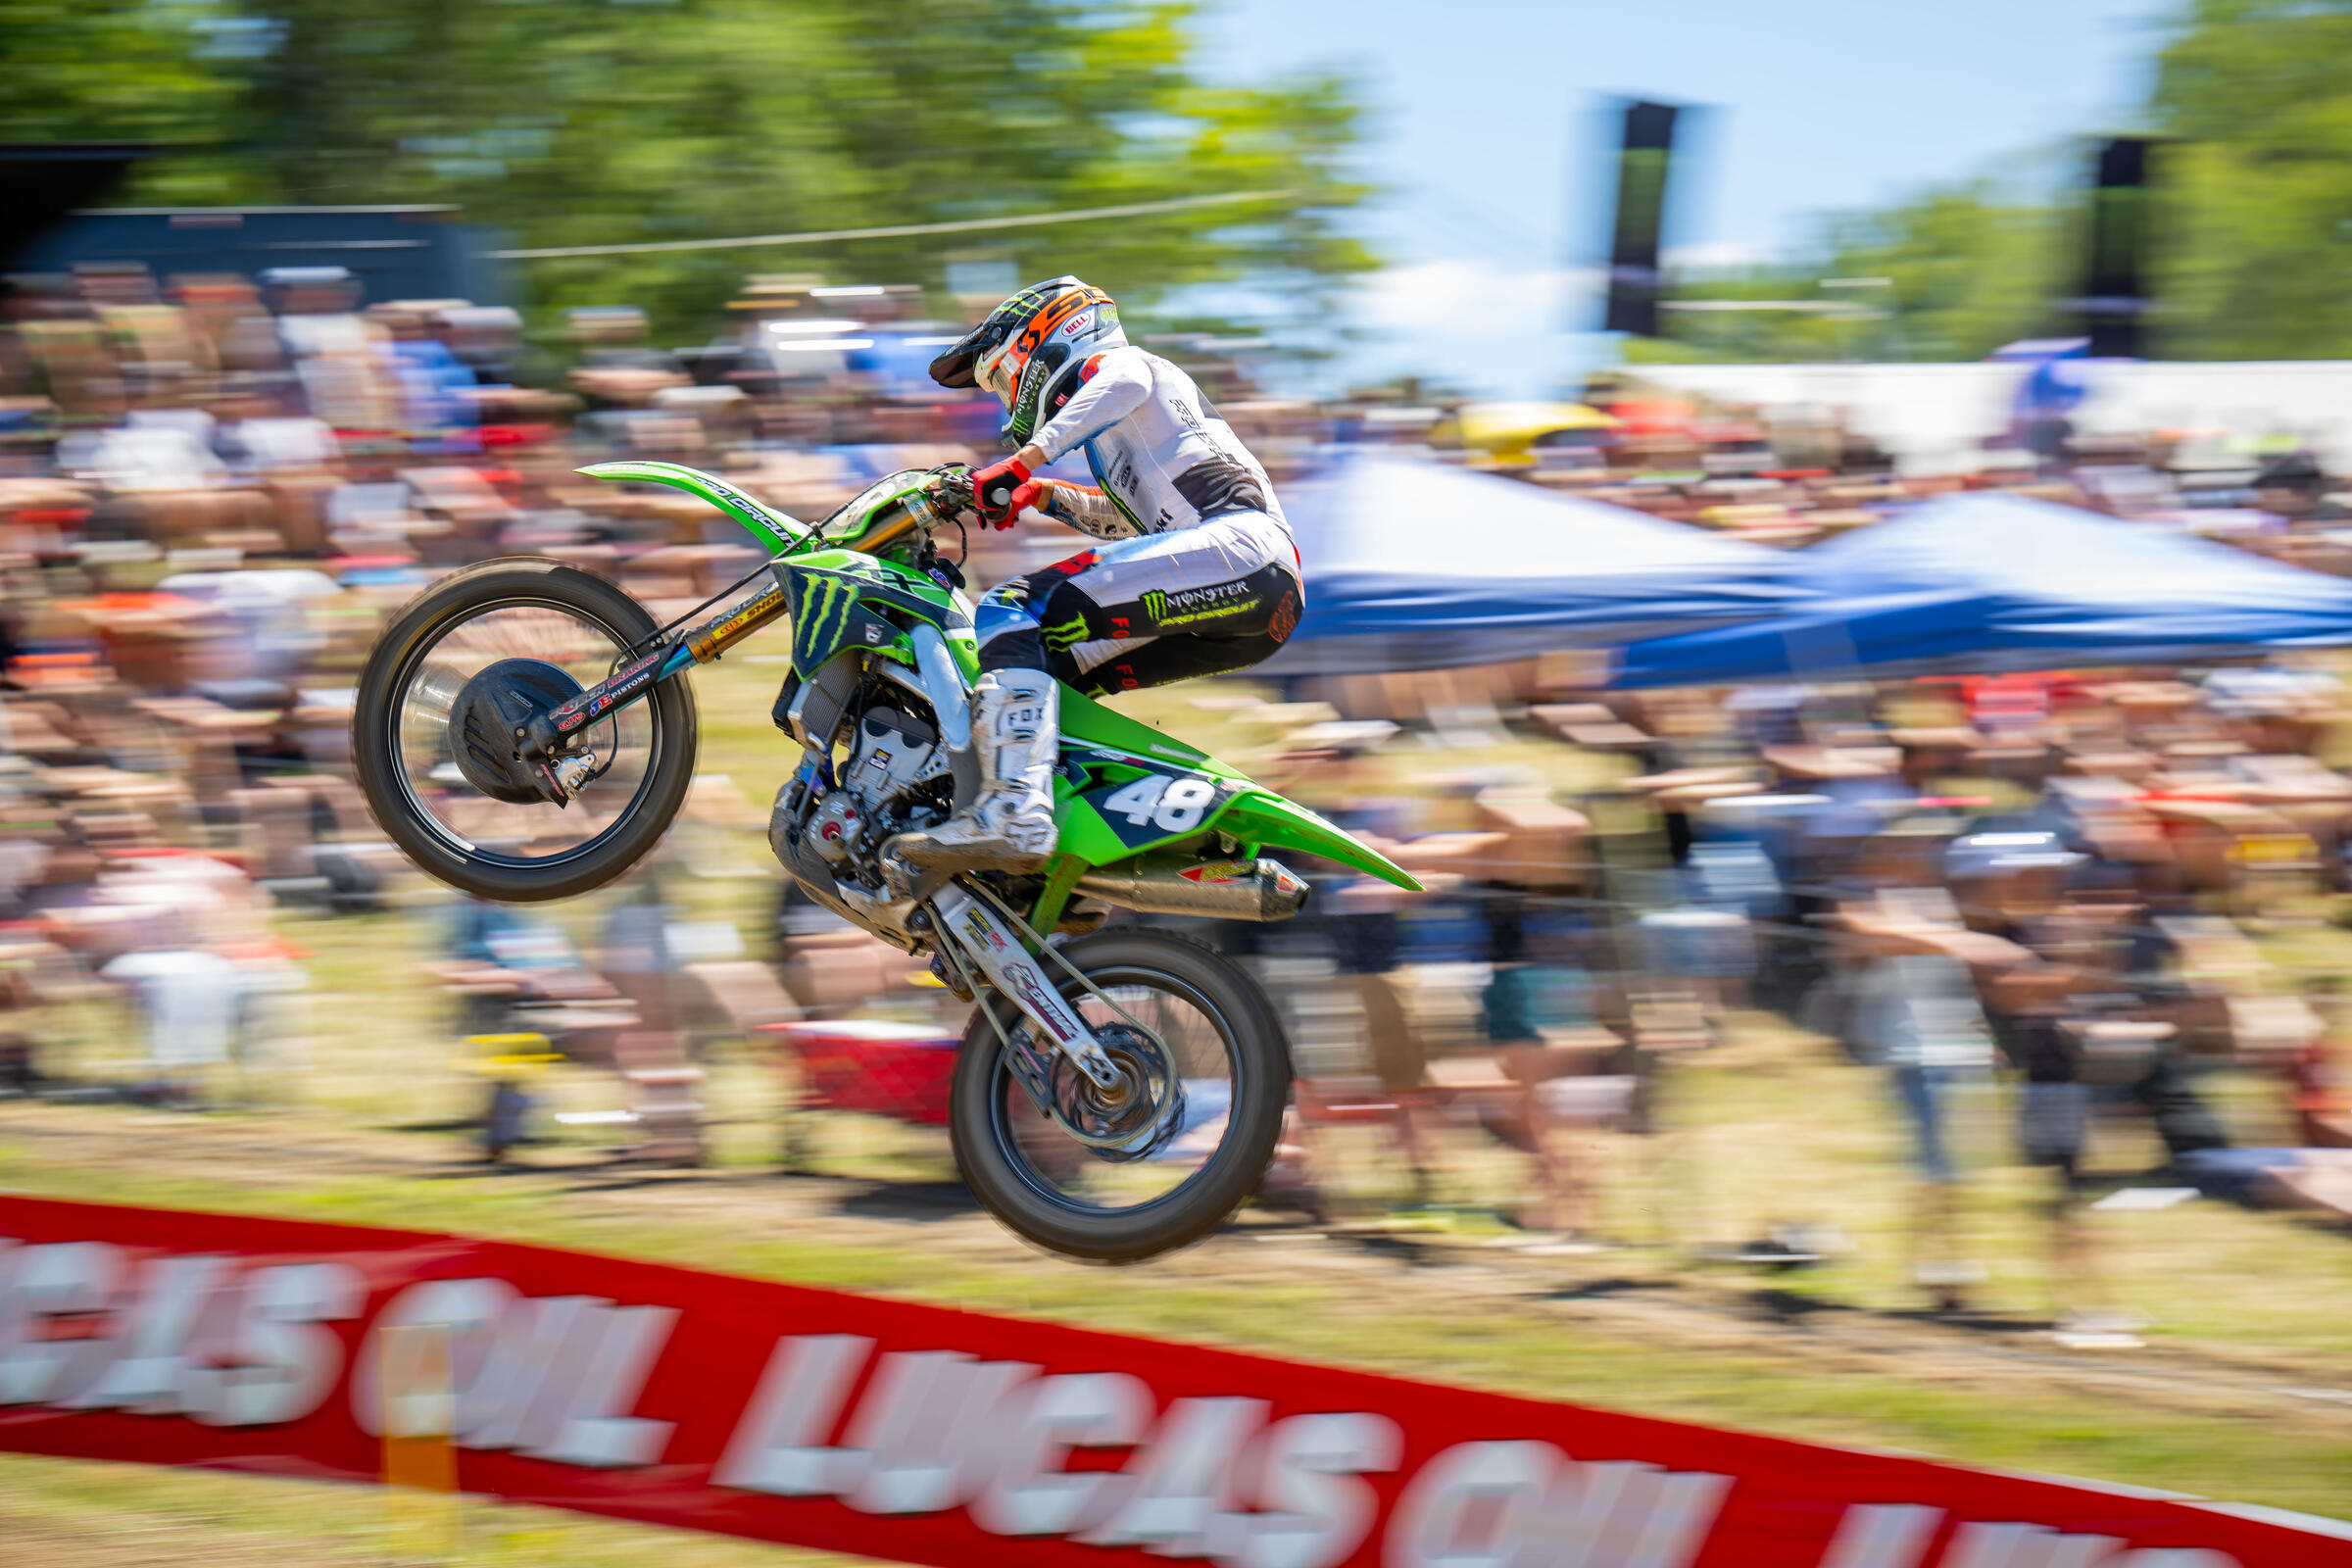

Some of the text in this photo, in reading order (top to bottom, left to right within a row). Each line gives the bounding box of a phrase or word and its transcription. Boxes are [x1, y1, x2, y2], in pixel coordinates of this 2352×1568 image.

[1064, 315, 1089, 335] BELL
[1017, 359, 1046, 416] MONSTER
[1166, 580, 1250, 609] MONSTER
[1110, 616, 1130, 639] FO
[608, 652, 661, 689] BRAKING
[612, 672, 651, 700] PISTONS
[1007, 707, 1044, 727] FOX
[1103, 773, 1216, 833] 48
[706, 1333, 1407, 1568] LUCAS
